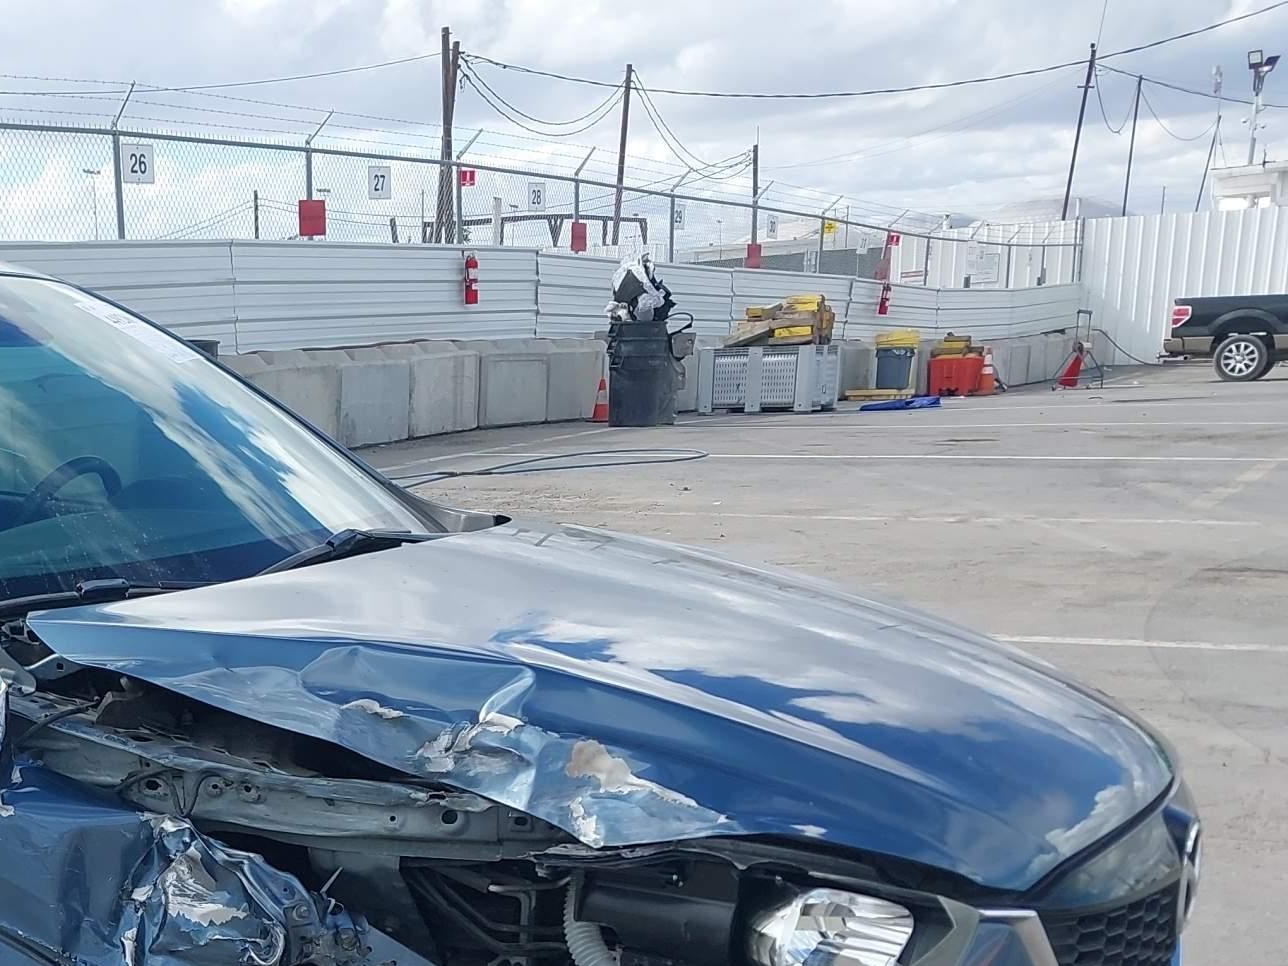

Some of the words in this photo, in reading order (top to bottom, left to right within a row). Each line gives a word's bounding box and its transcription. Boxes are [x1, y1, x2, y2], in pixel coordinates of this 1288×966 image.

[130, 153, 147, 174] 26
[373, 174, 386, 191] 27
[531, 189, 542, 205] 28
